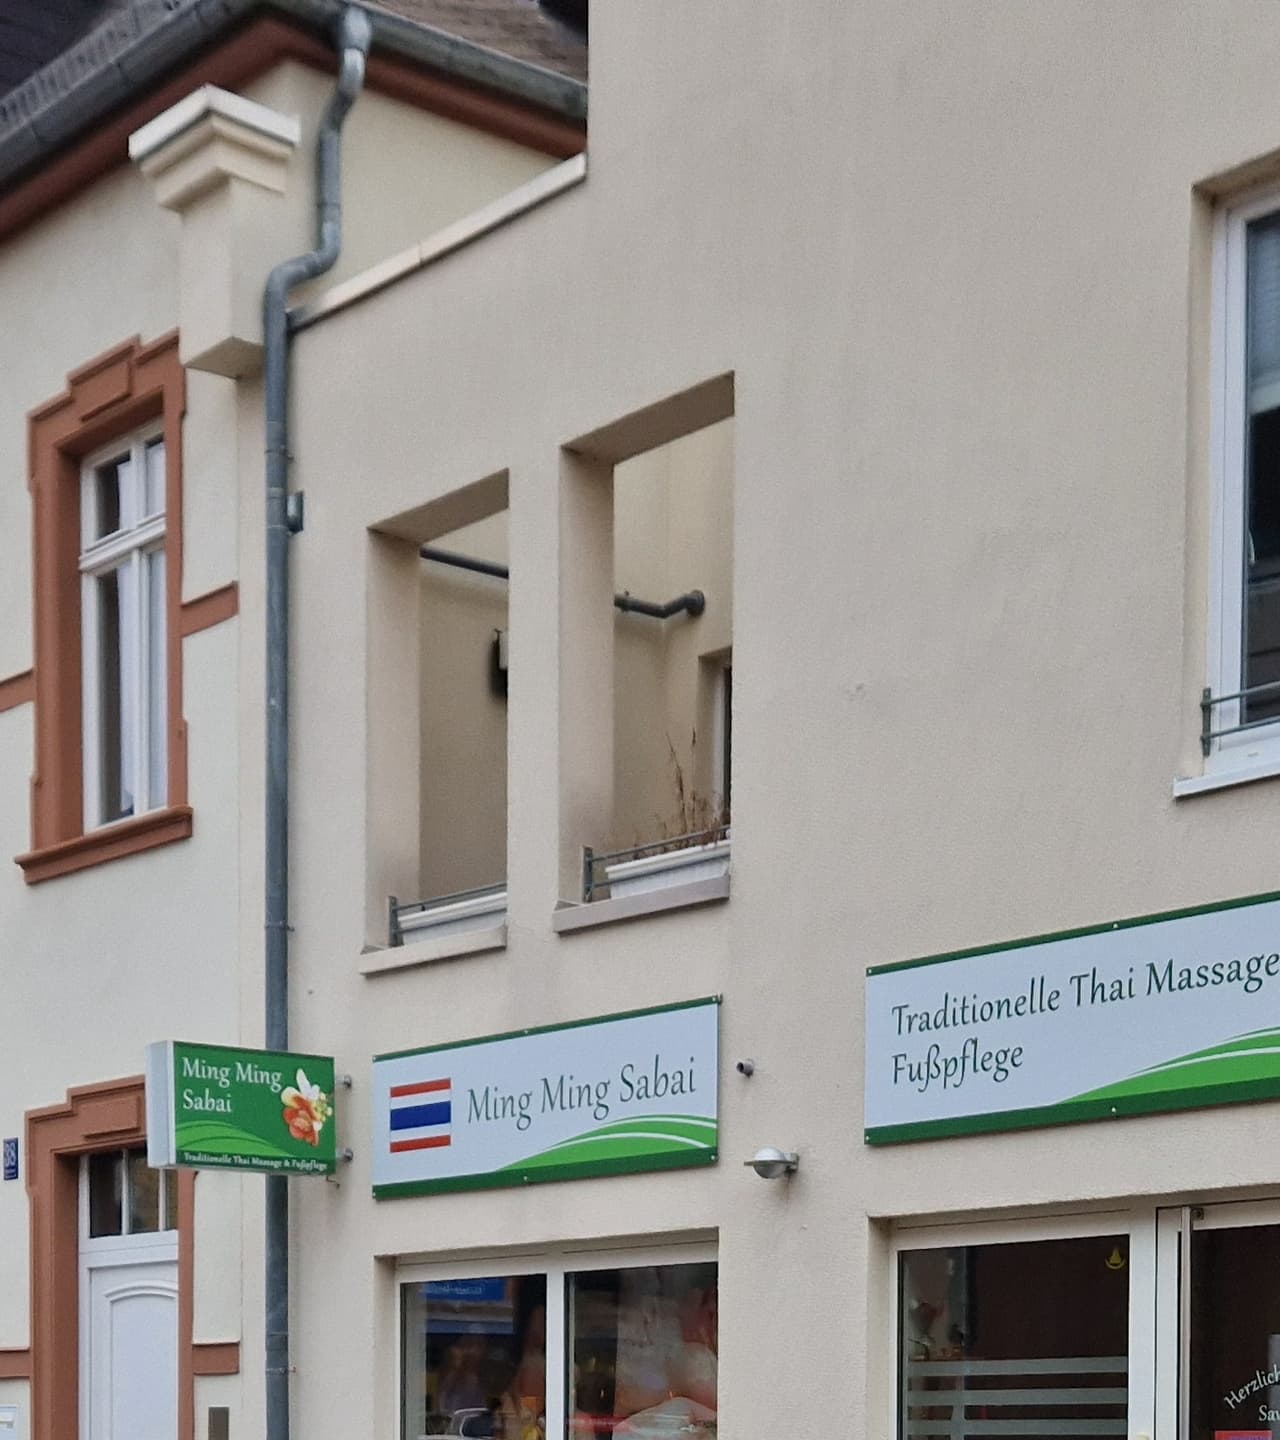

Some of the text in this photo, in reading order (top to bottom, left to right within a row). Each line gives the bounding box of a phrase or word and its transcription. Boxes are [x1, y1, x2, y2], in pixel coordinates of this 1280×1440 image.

[891, 975, 1060, 1036] Traditionelle
[1069, 966, 1136, 1007] Thai
[1145, 951, 1280, 993] Massage
[182, 1056, 283, 1093] Ming Ming
[891, 1036, 1024, 1093] Fußpflege
[183, 1087, 232, 1113] Sabai
[467, 1053, 697, 1131] Ming Ming Sabai
[184, 1152, 232, 1163] Traditionelle
[233, 1155, 250, 1165] Thai
